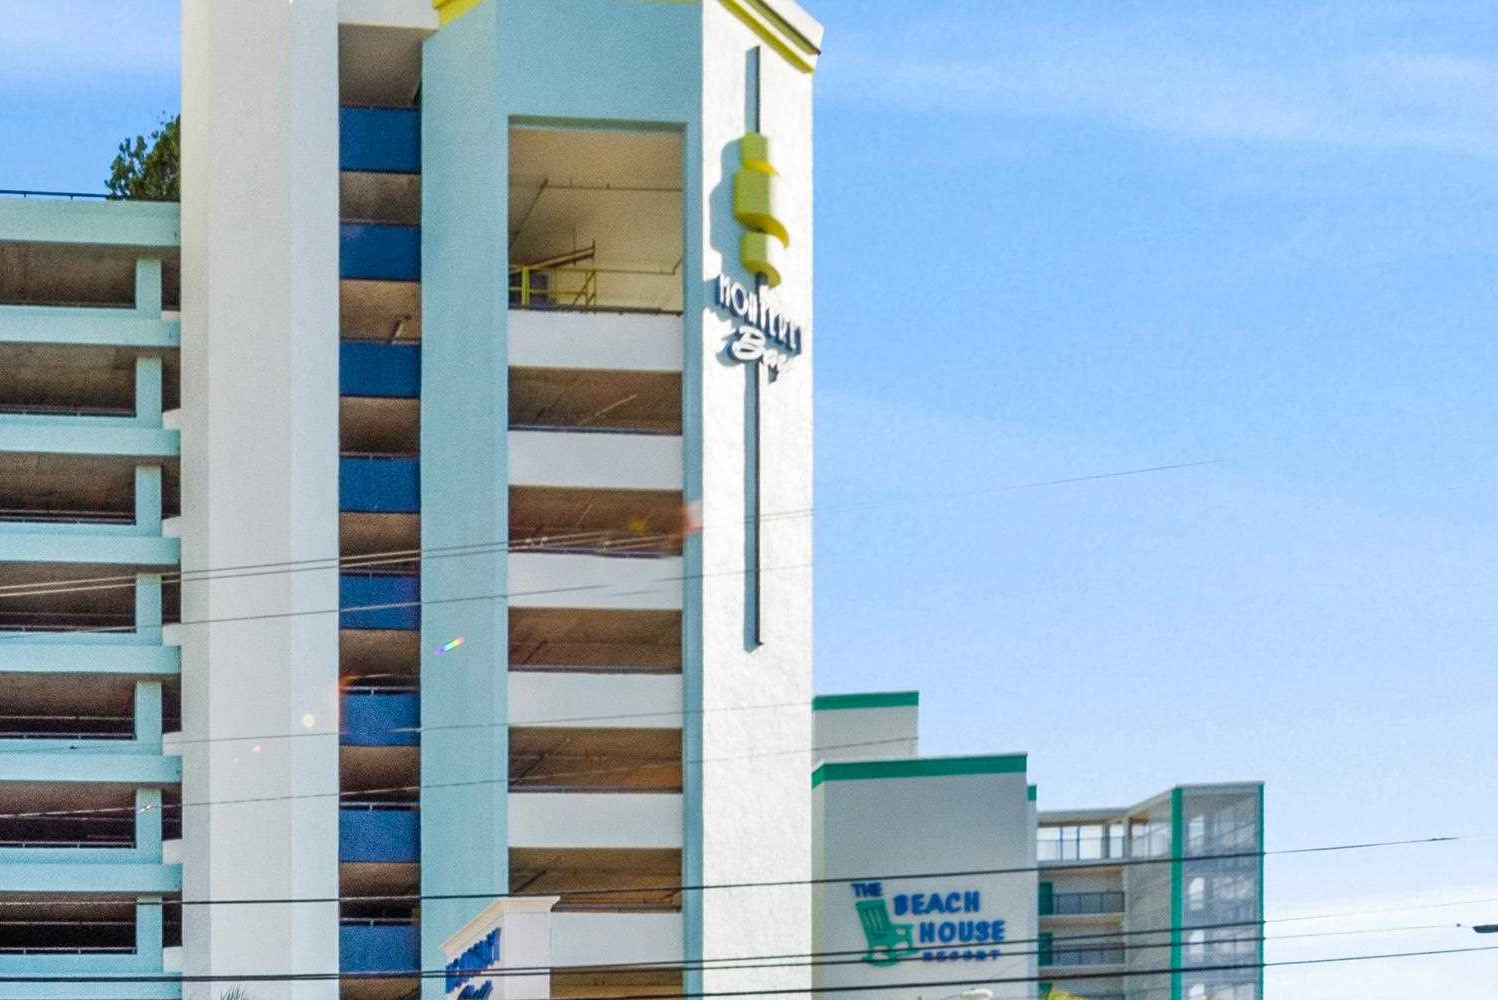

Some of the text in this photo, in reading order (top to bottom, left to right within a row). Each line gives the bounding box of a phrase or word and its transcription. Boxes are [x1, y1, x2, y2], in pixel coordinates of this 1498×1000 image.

[851, 882, 883, 897] THE
[893, 890, 981, 916] BEACH
[918, 919, 1006, 944] HOUSE
